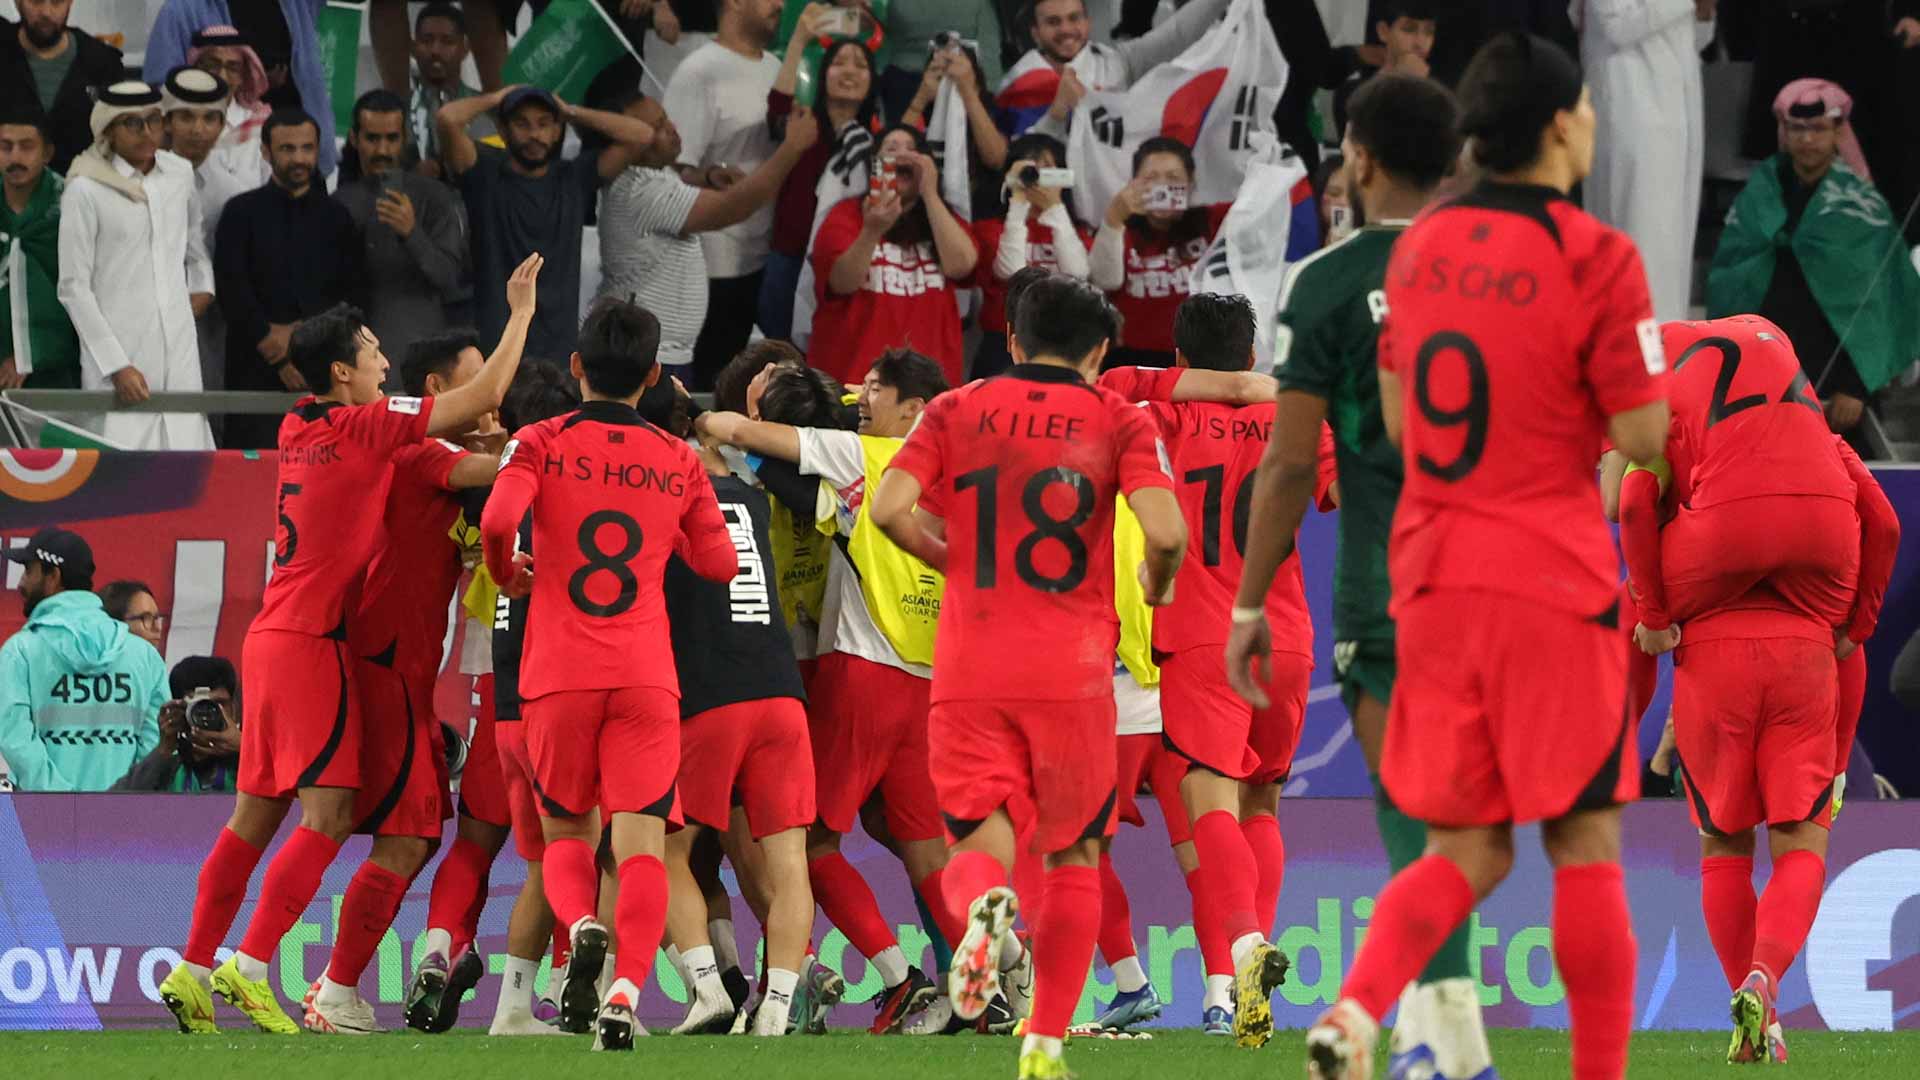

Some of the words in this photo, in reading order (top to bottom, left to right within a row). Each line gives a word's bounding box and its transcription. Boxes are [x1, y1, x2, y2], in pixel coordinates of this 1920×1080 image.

[1430, 259, 1449, 292] S
[1458, 264, 1538, 306] CHO
[979, 409, 996, 433] K
[1010, 411, 1016, 435] I
[1027, 413, 1085, 440] LEE
[1210, 418, 1226, 439] S
[1415, 330, 1490, 482] 9
[544, 453, 564, 475] H
[575, 457, 591, 480] S
[604, 463, 685, 497] HONG
[275, 482, 303, 567] 5
[955, 464, 1095, 593] 18
[568, 509, 643, 617] 8
[901, 594, 930, 607] ASIAN
[51, 672, 132, 704] 4505
